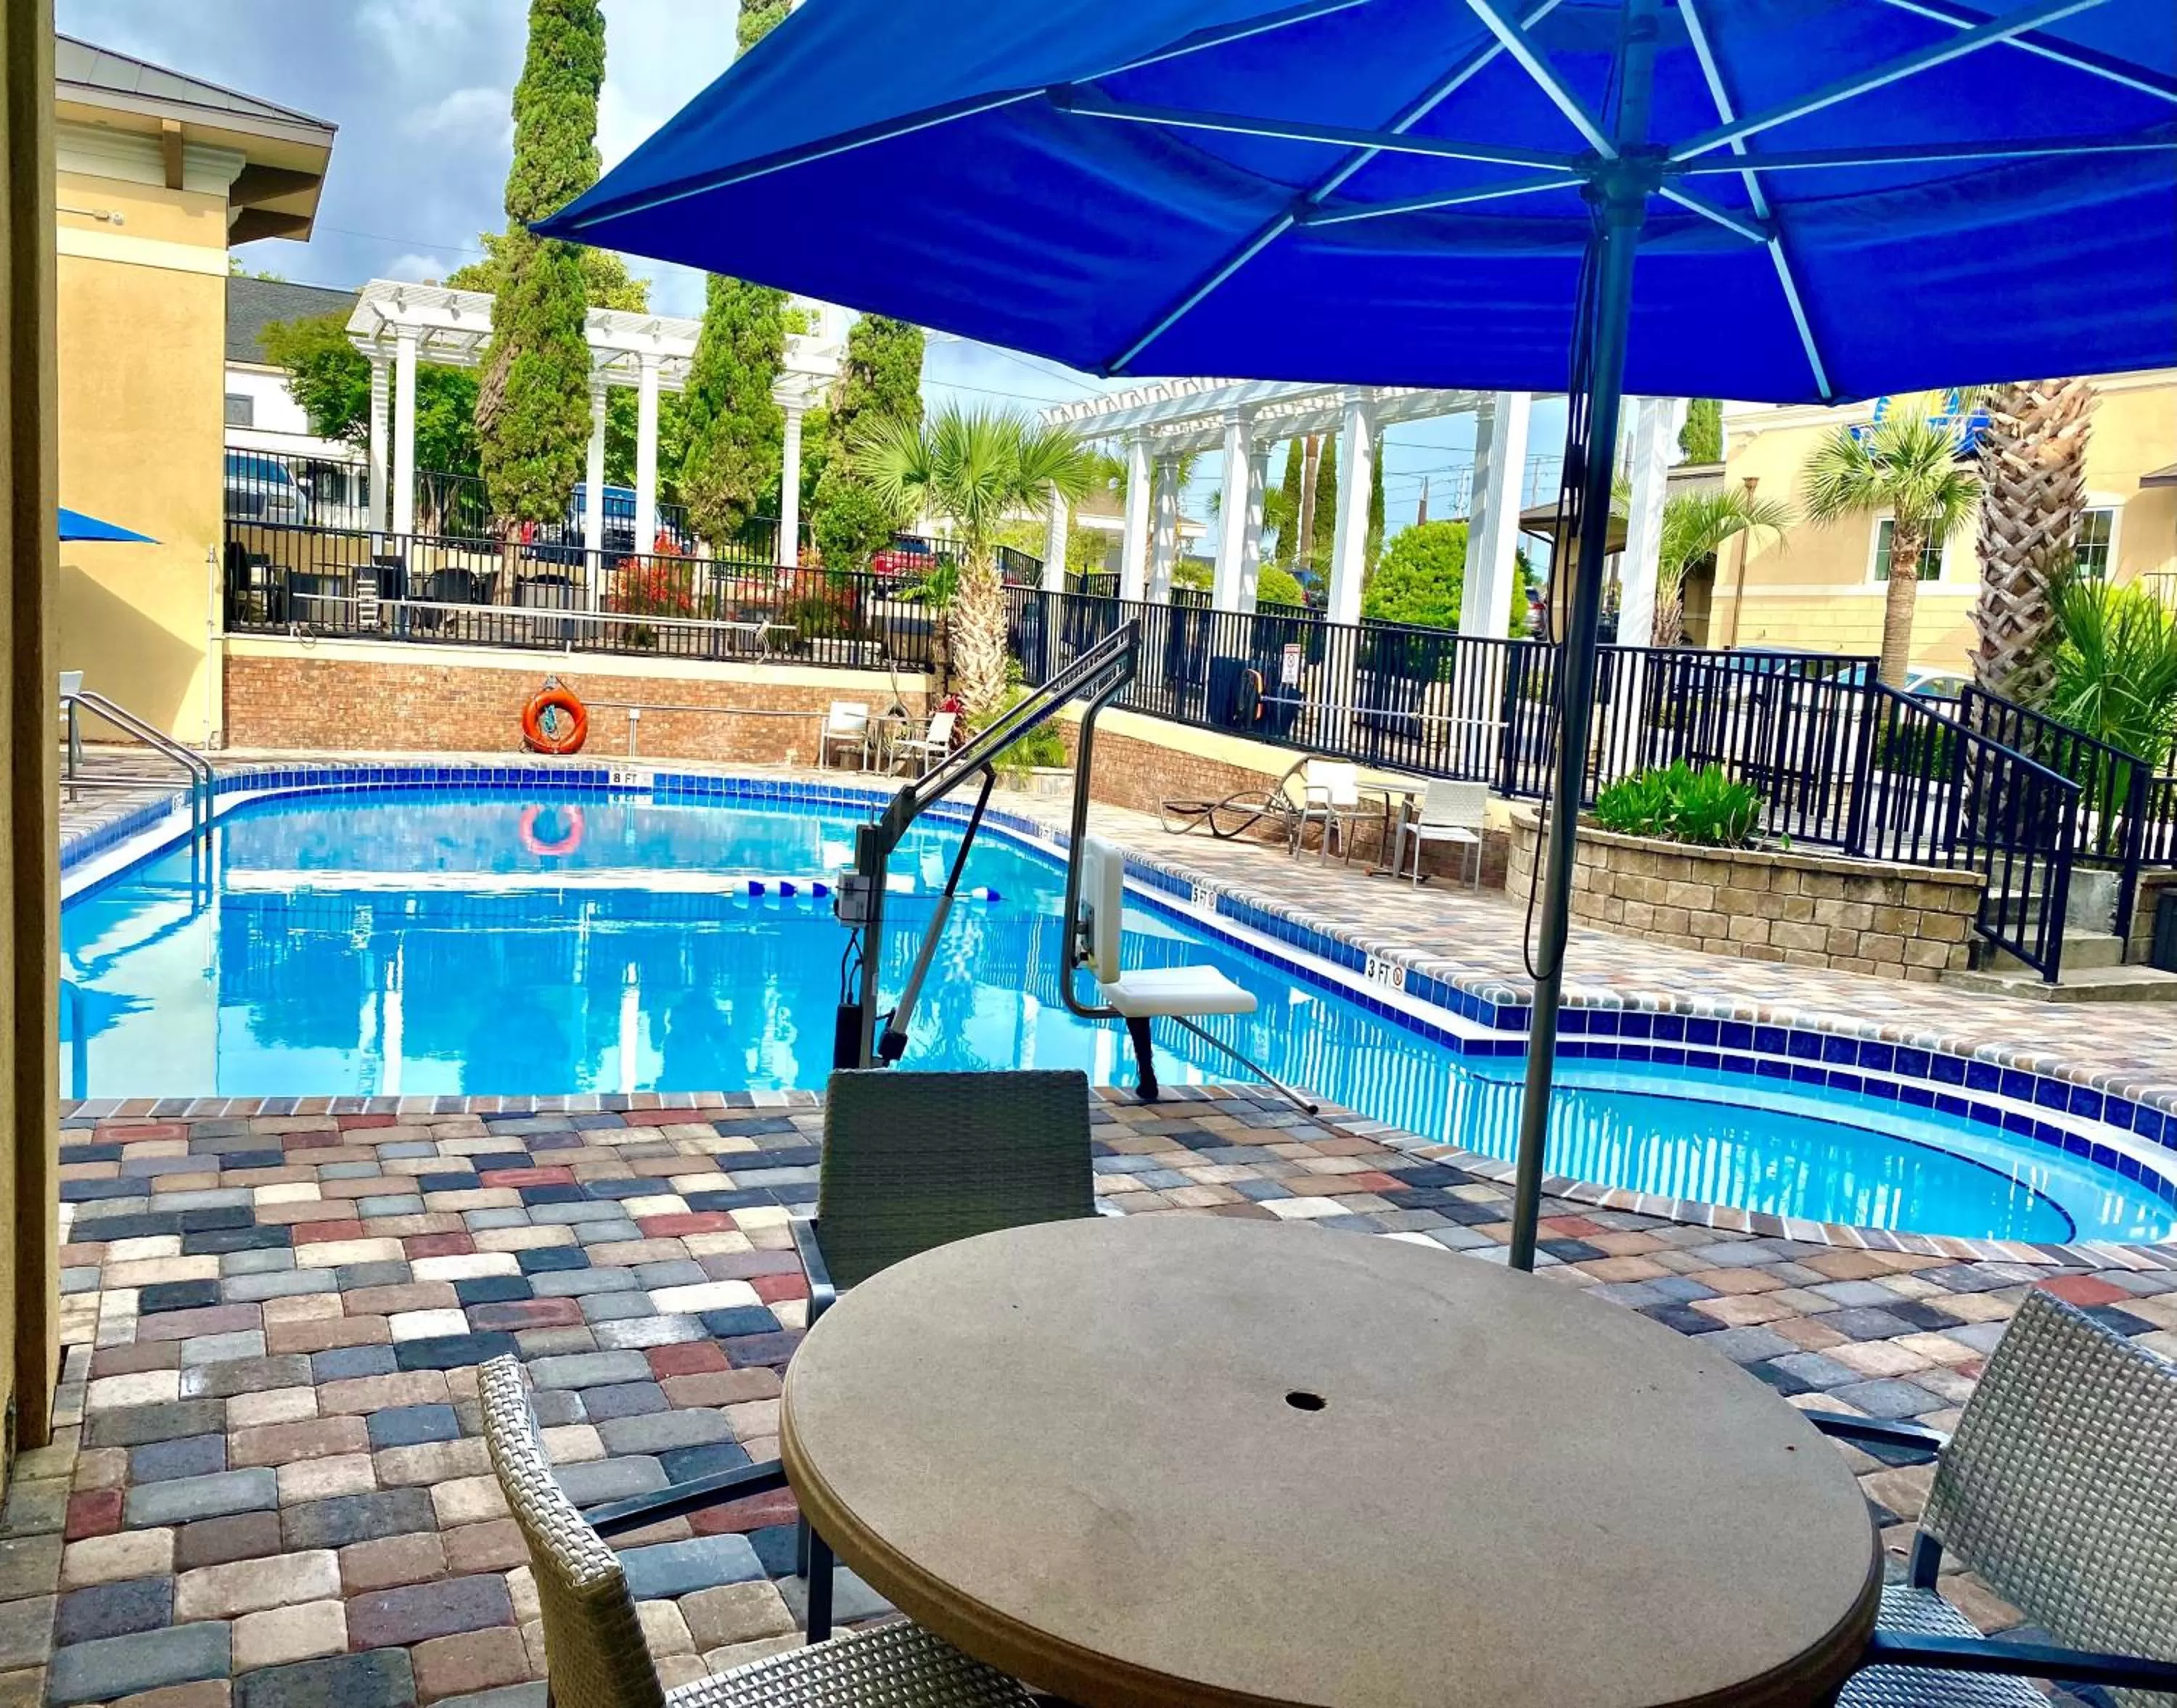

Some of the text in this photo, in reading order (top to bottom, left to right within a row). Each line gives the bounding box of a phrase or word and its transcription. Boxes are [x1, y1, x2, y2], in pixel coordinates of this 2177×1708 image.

[613, 773, 637, 784] 8 FT
[1193, 887, 1208, 906] 5 FT
[1368, 958, 1391, 985] 3 FT
